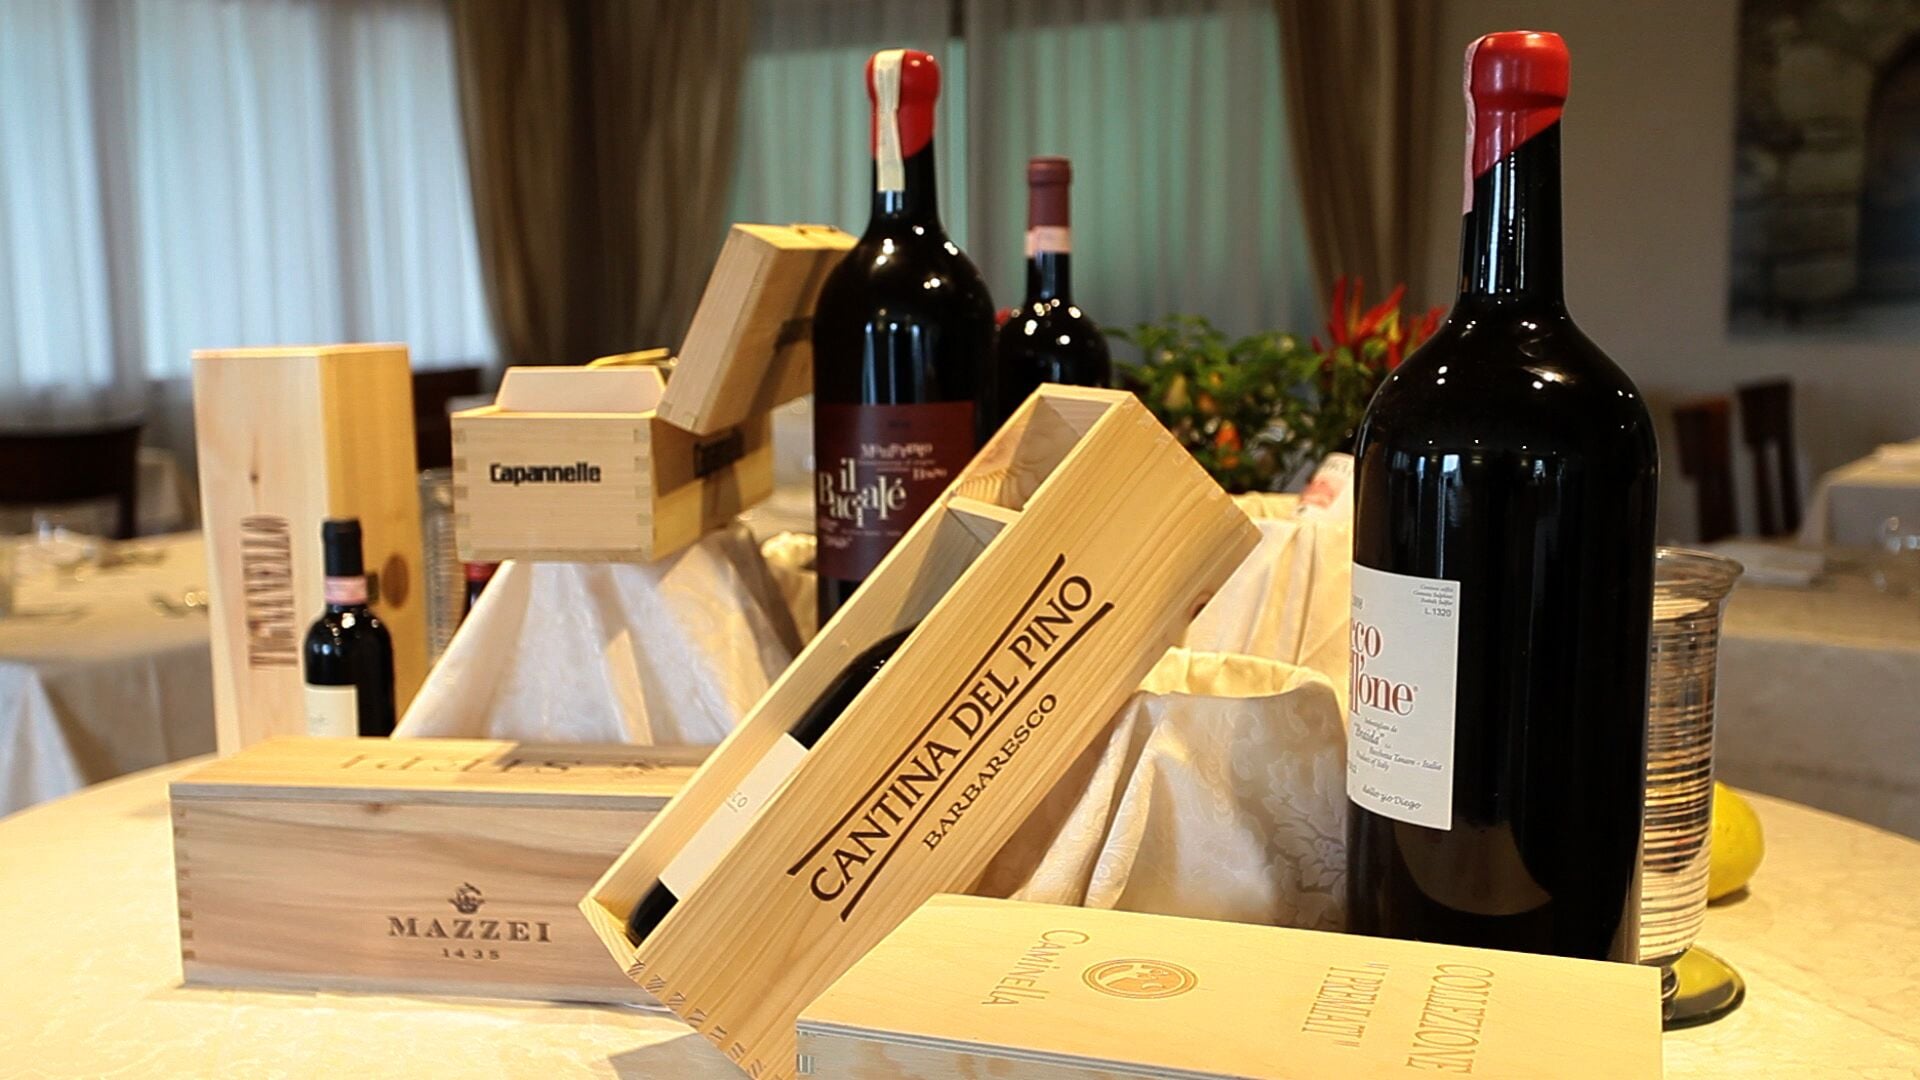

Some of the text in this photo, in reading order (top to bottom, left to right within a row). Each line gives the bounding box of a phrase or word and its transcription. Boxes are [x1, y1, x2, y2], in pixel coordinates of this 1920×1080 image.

[489, 461, 602, 485] Capannelle
[839, 457, 857, 492] il
[1352, 621, 1381, 658] co
[809, 575, 1092, 902] CANTINA DEL PINO
[921, 693, 1057, 851] BARBARESCO
[388, 916, 552, 943] MAZZEI
[441, 948, 500, 961] 1435
[1406, 964, 1494, 1074] COLLEZIONE
